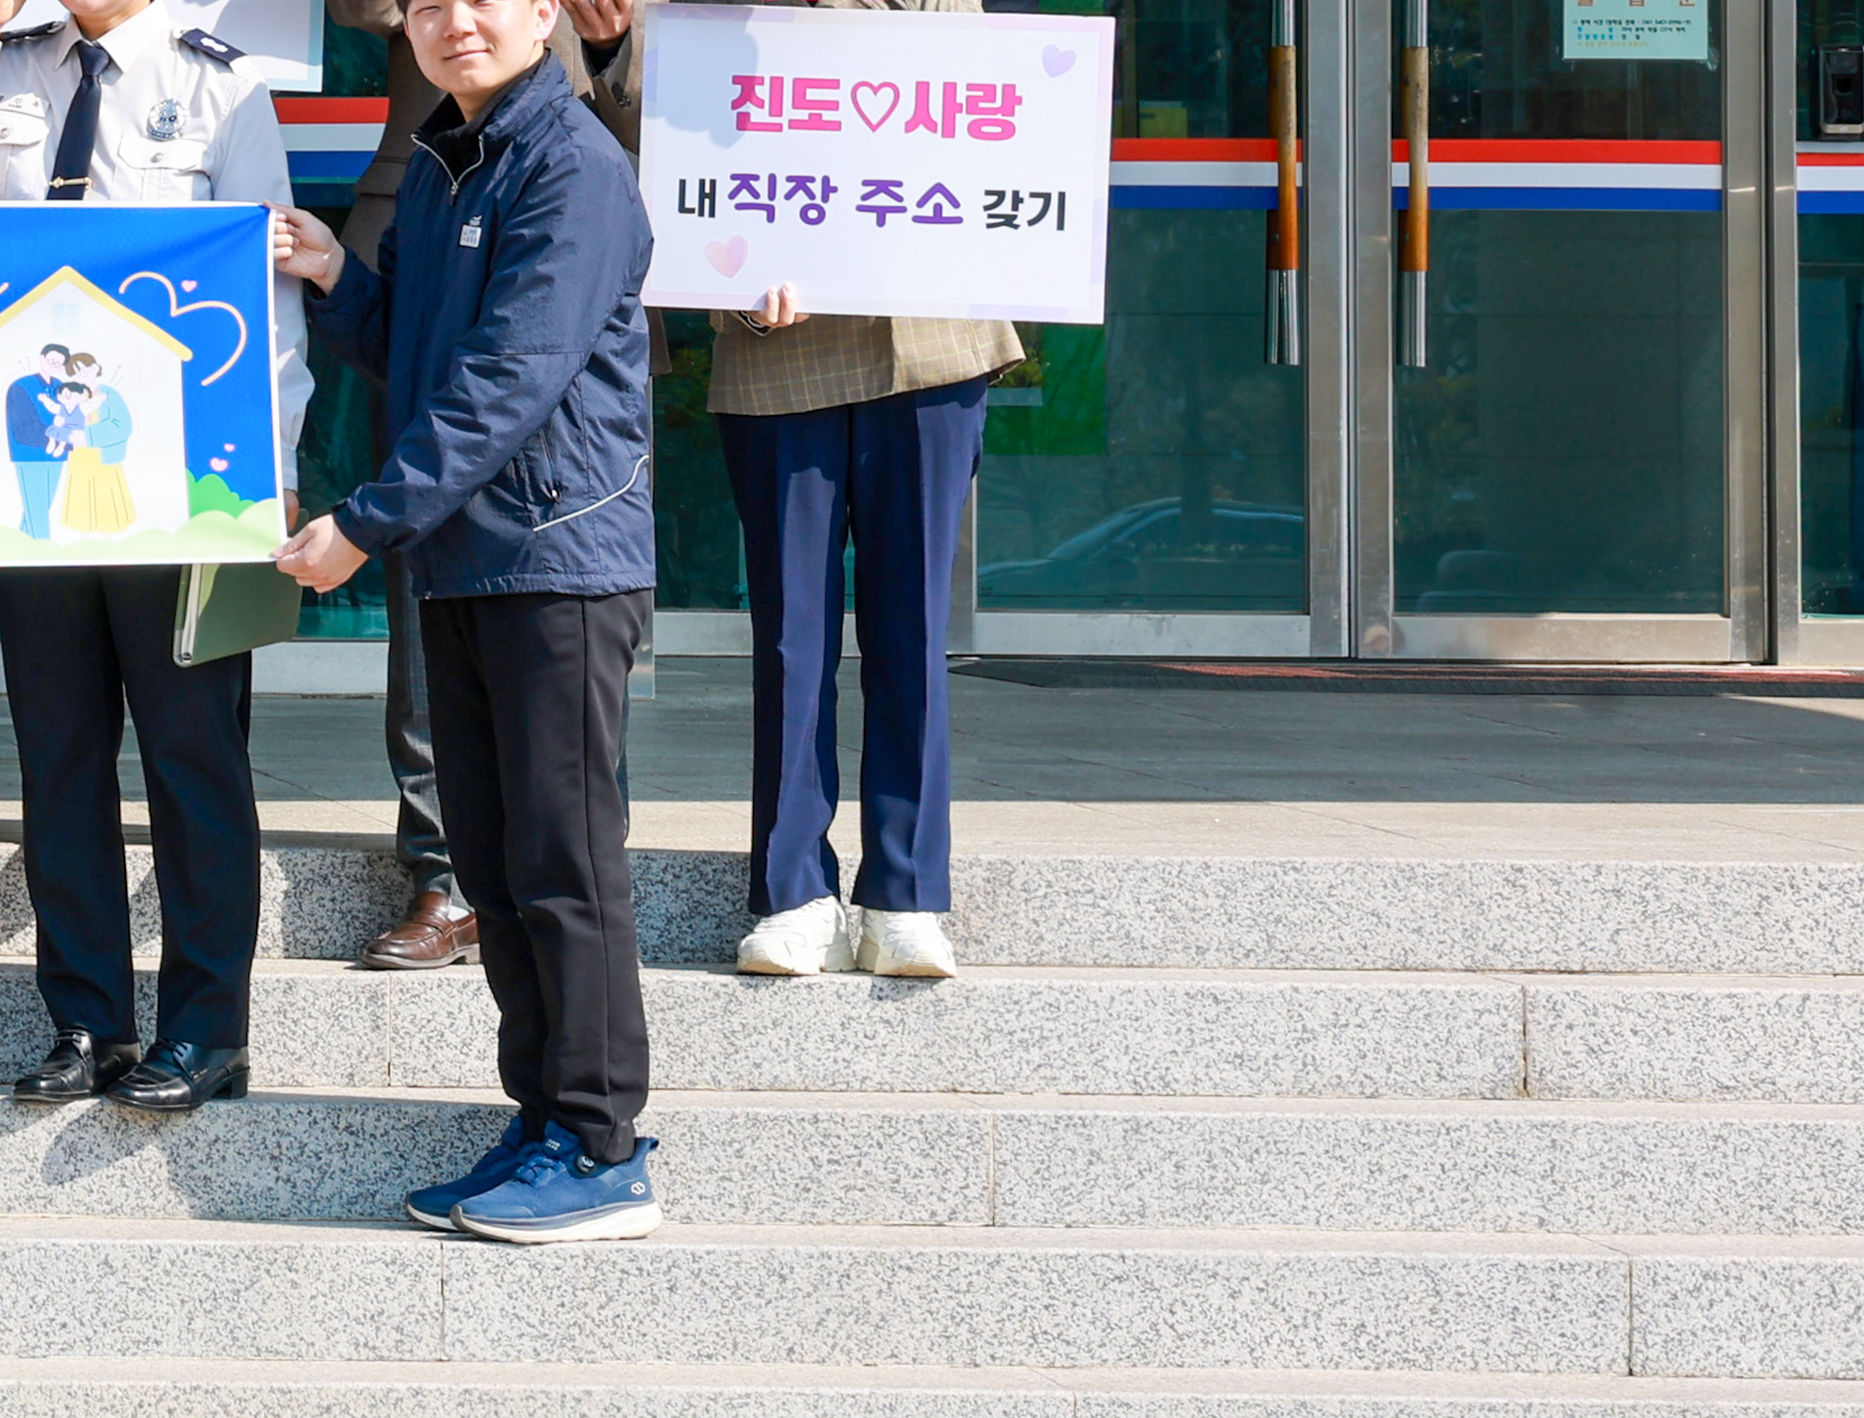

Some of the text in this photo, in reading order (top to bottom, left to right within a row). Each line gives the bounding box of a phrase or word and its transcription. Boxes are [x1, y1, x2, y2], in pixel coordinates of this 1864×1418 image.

[731, 74, 1023, 141] 진도 사랑
[855, 179, 964, 228] 주소
[982, 189, 1067, 232] 갖기
